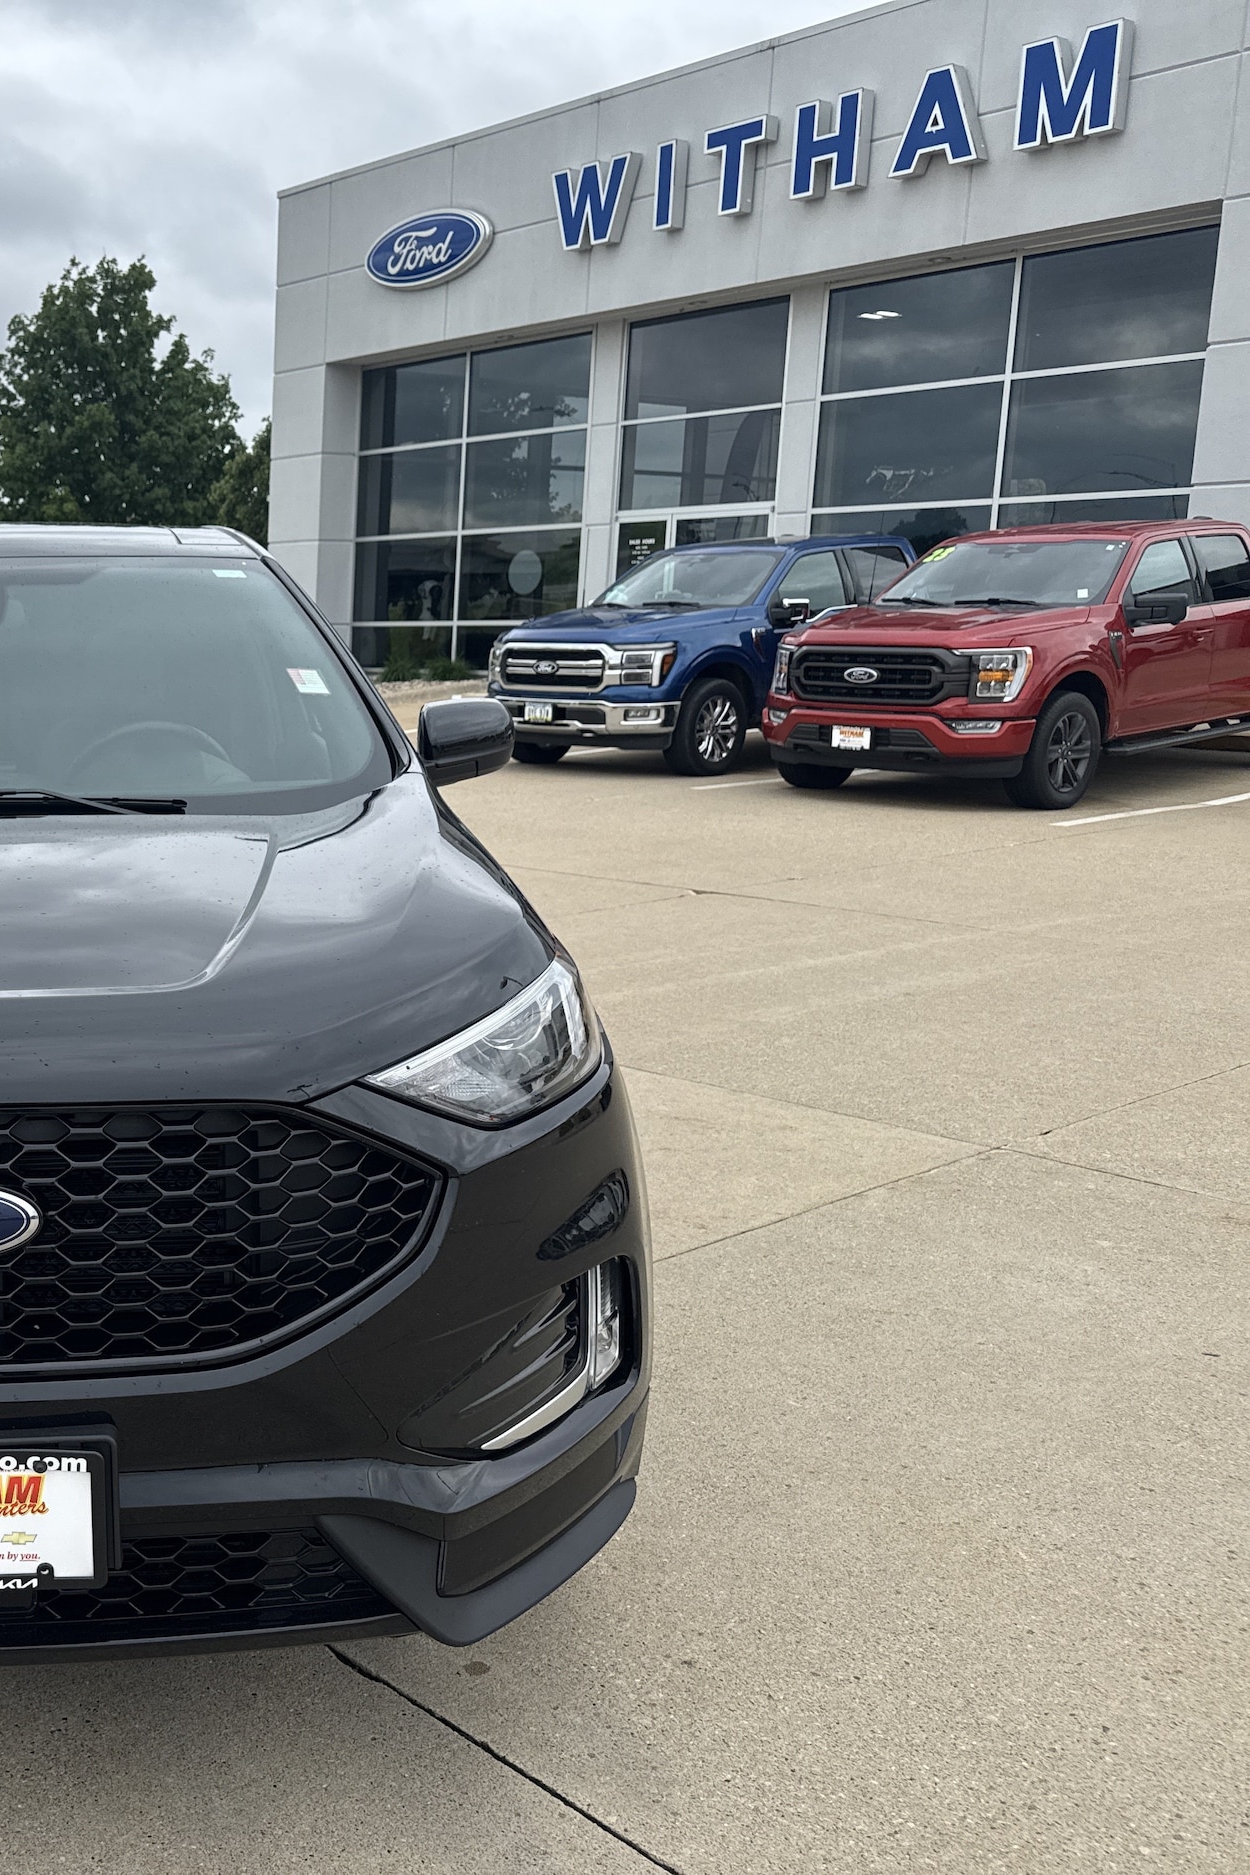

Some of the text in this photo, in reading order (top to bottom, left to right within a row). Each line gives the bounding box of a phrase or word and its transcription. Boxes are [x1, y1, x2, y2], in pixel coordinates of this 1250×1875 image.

[552, 17, 1134, 252] WITHAM
[387, 226, 455, 275] Ford
[7, 1551, 18, 1562] by
[19, 1552, 41, 1562] you.
